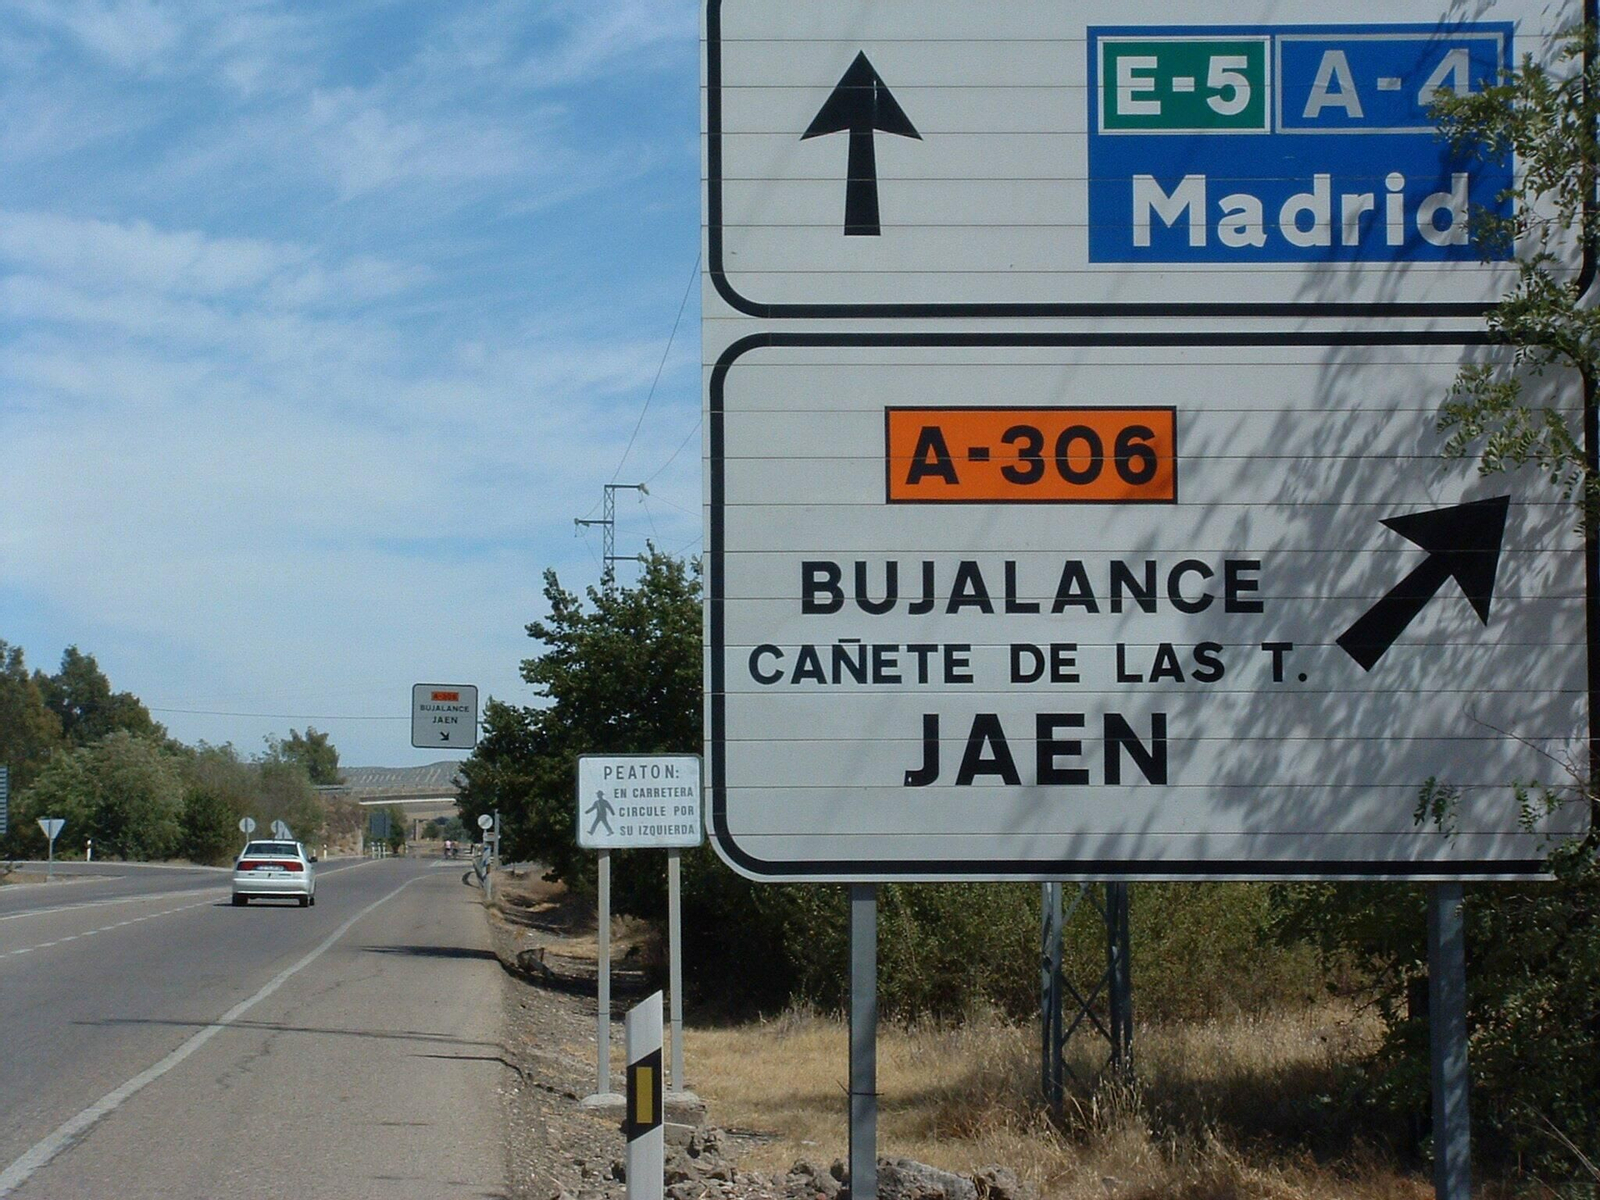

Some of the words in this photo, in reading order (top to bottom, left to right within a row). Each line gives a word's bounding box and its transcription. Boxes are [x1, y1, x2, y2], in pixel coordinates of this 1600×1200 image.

[1116, 56, 1251, 115] E-5
[1302, 49, 1475, 118] A-4
[1133, 172, 1469, 248] Madrid
[905, 425, 1158, 485] A-306
[801, 559, 1264, 615] BUJALANCE
[748, 638, 974, 685] CAÑETE
[1010, 642, 1080, 683] DE
[1116, 641, 1225, 683] LAS
[1262, 642, 1309, 683] T.
[420, 704, 469, 713] BUJALANCE
[432, 716, 459, 724] JAEN
[604, 764, 680, 780] PEATON:
[904, 712, 1169, 786] JAEN
[614, 788, 627, 799] EN
[632, 787, 694, 799] CARRETERA
[619, 806, 667, 817] CIRCULE
[673, 805, 694, 816] POR
[619, 825, 633, 836] SU
[638, 824, 695, 836] IZQUIERDA
